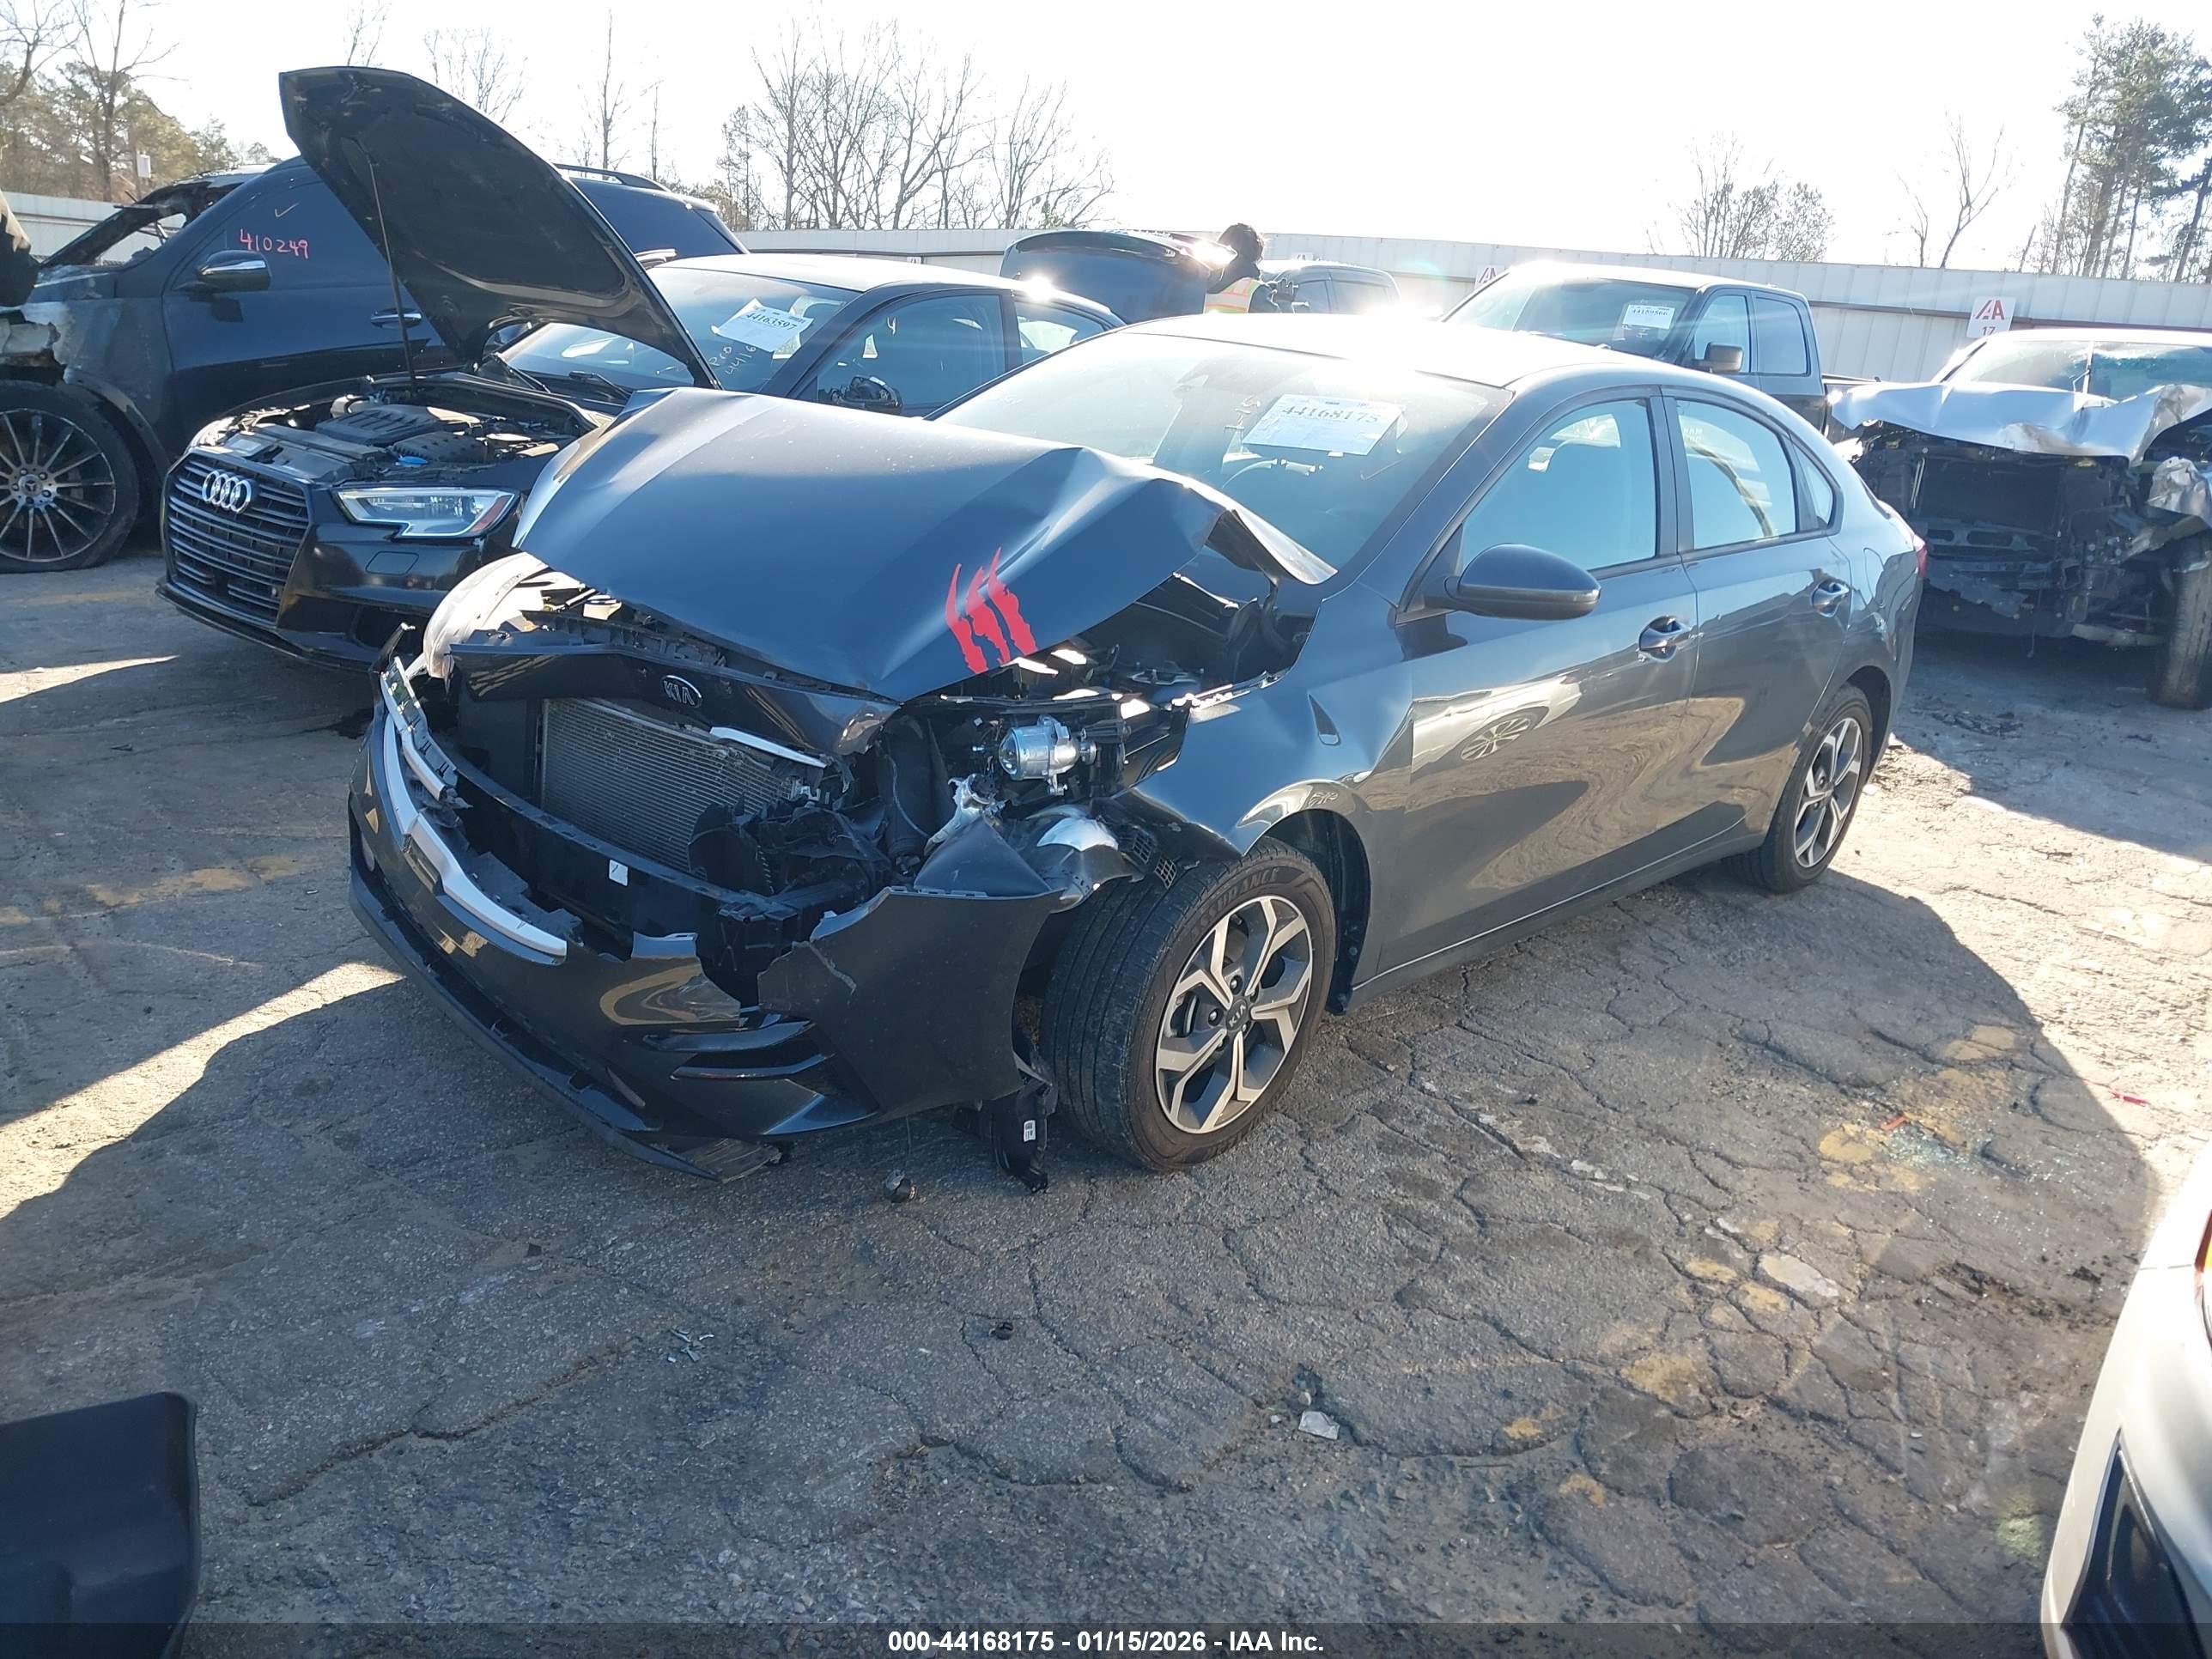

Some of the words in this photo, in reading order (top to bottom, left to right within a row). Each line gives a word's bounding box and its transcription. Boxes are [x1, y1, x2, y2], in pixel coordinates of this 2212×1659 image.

[240, 228, 309, 259] 410249
[1982, 326, 1996, 336] 17
[1281, 405, 1382, 423] 44168175
[664, 680, 696, 706] KIA
[1228, 1004, 1247, 1028] KIA
